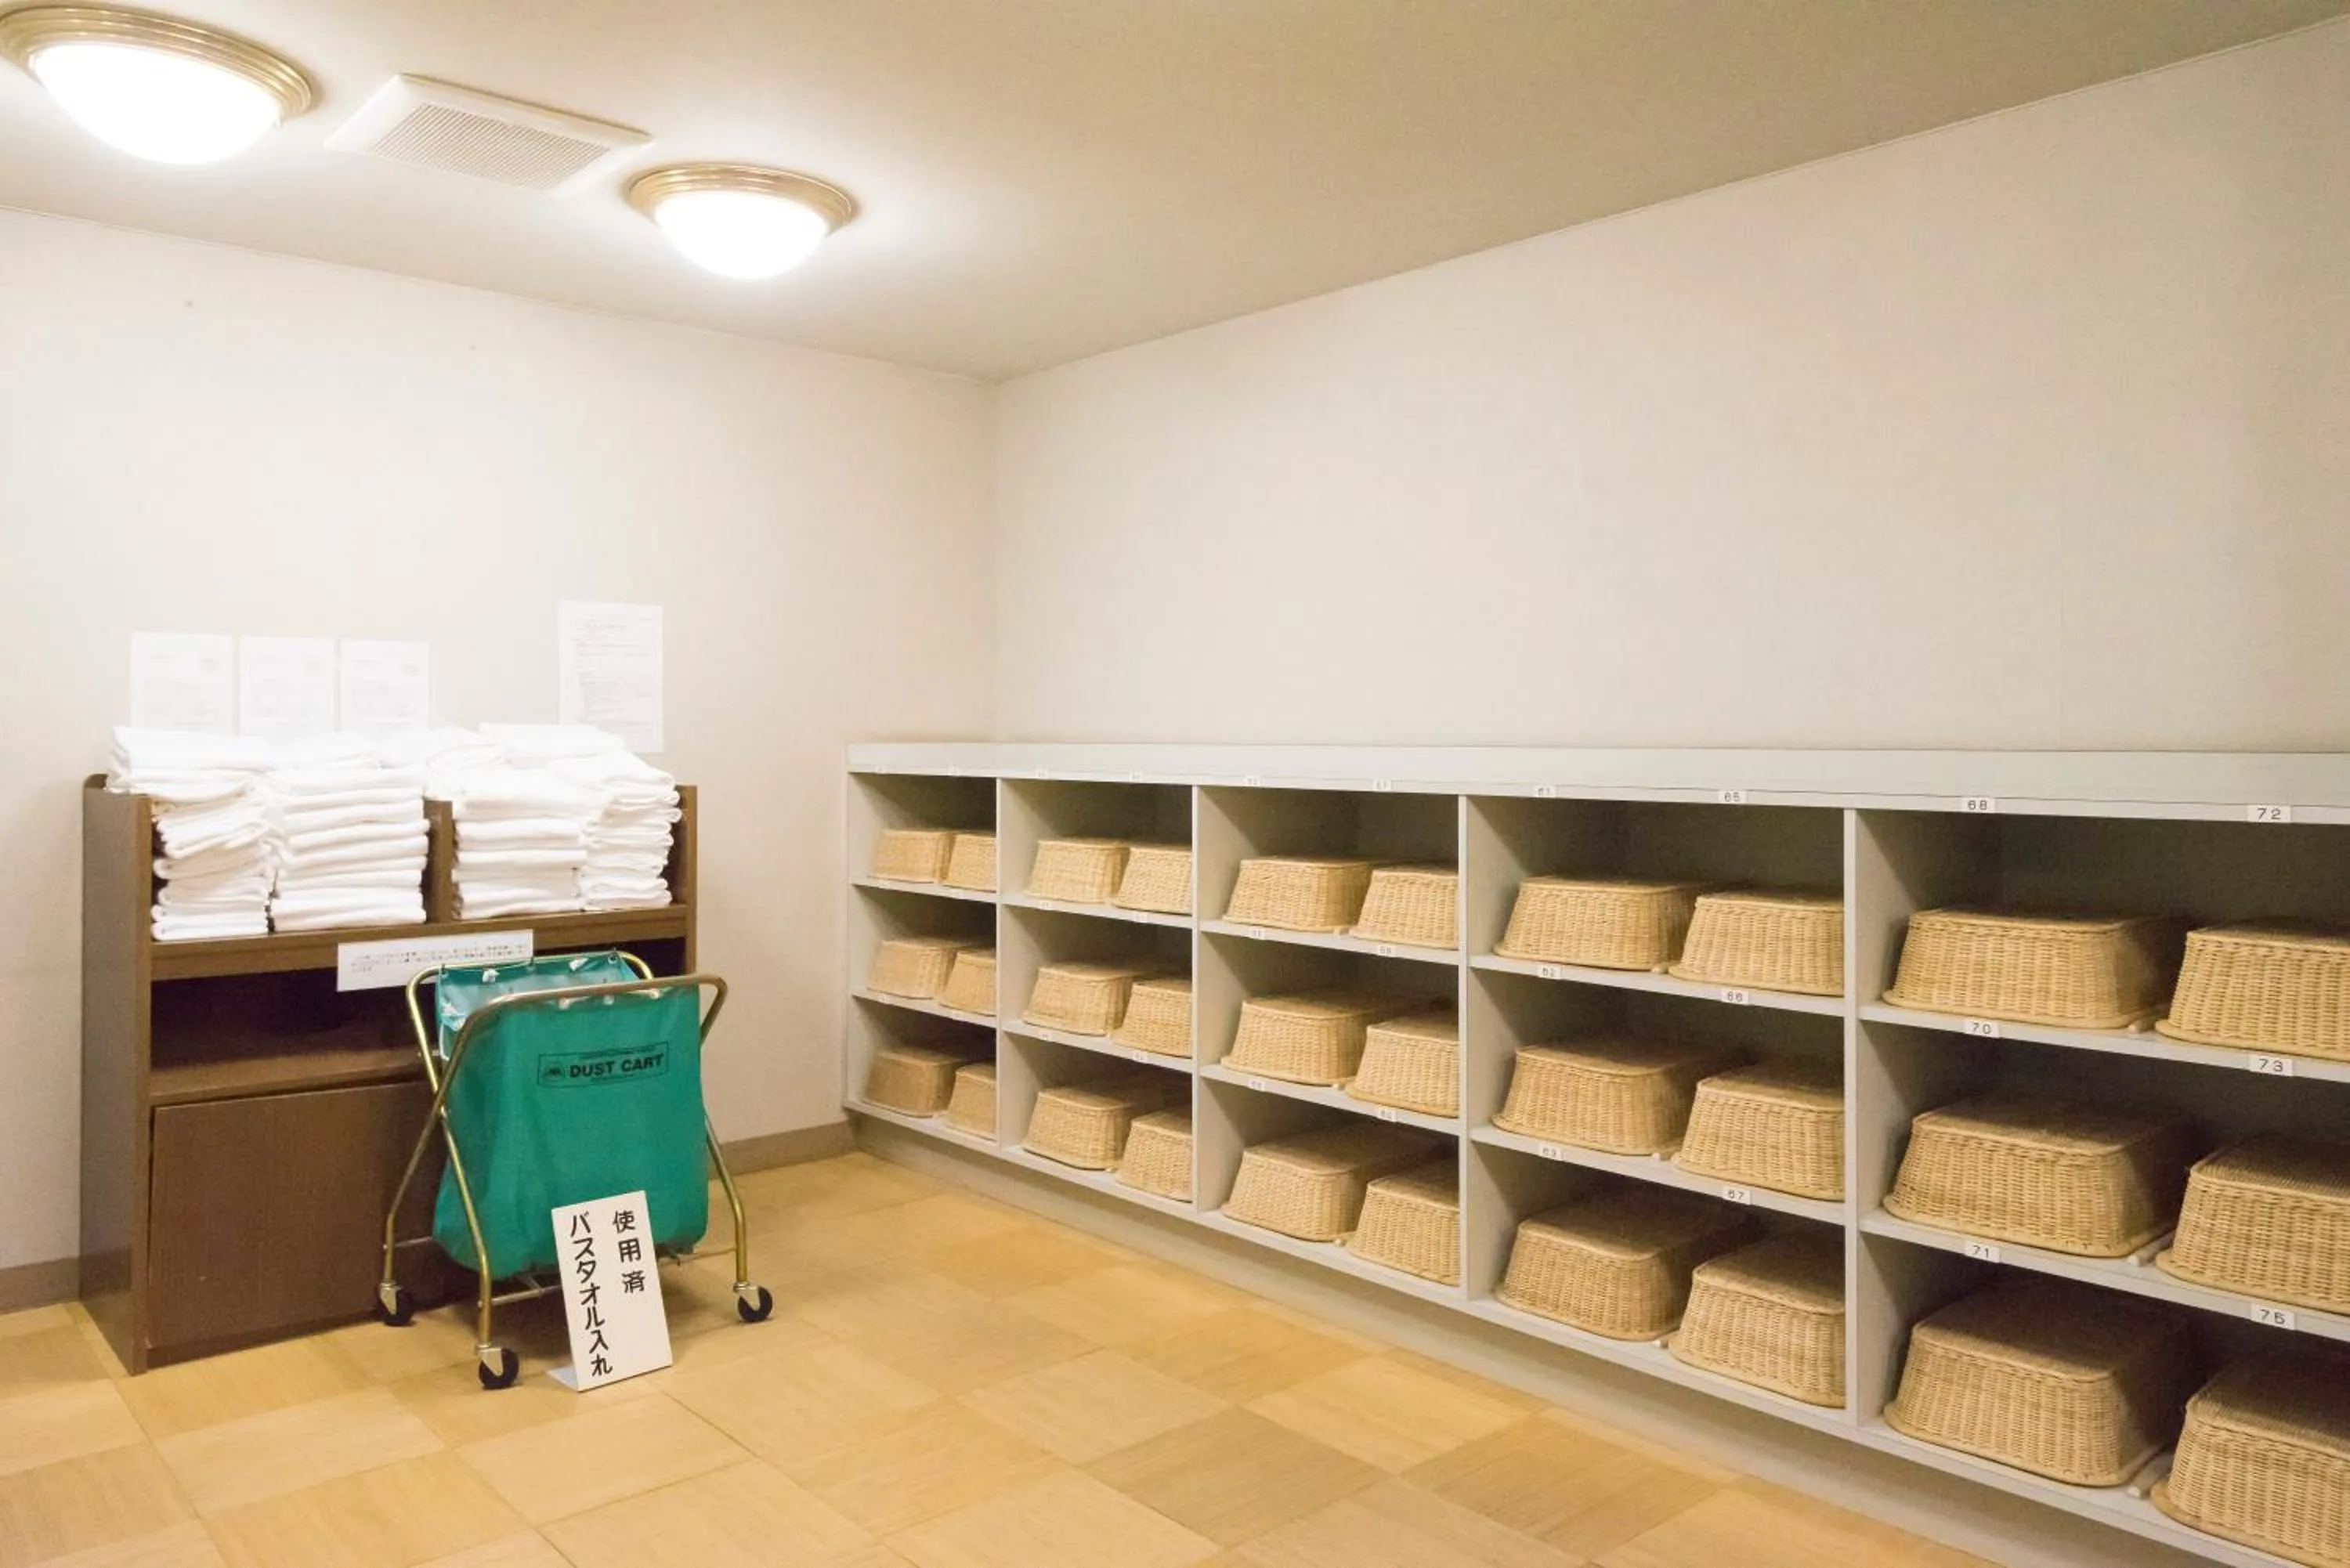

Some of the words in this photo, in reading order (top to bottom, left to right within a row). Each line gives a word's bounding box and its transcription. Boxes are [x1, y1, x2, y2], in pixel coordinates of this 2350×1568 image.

[1723, 791, 1741, 802] 65
[1967, 800, 1988, 811] 68
[2257, 807, 2283, 821] 72
[1970, 1021, 1991, 1035] 70
[569, 1061, 615, 1078] DUST
[621, 1053, 664, 1072] CART
[2258, 1058, 2283, 1073] 73
[1727, 1189, 1744, 1201] 67
[612, 1210, 645, 1294] 使用済
[1972, 1244, 1990, 1259] 71
[569, 1211, 613, 1377] バスタオル入れ
[2259, 1308, 2286, 1325] 75
